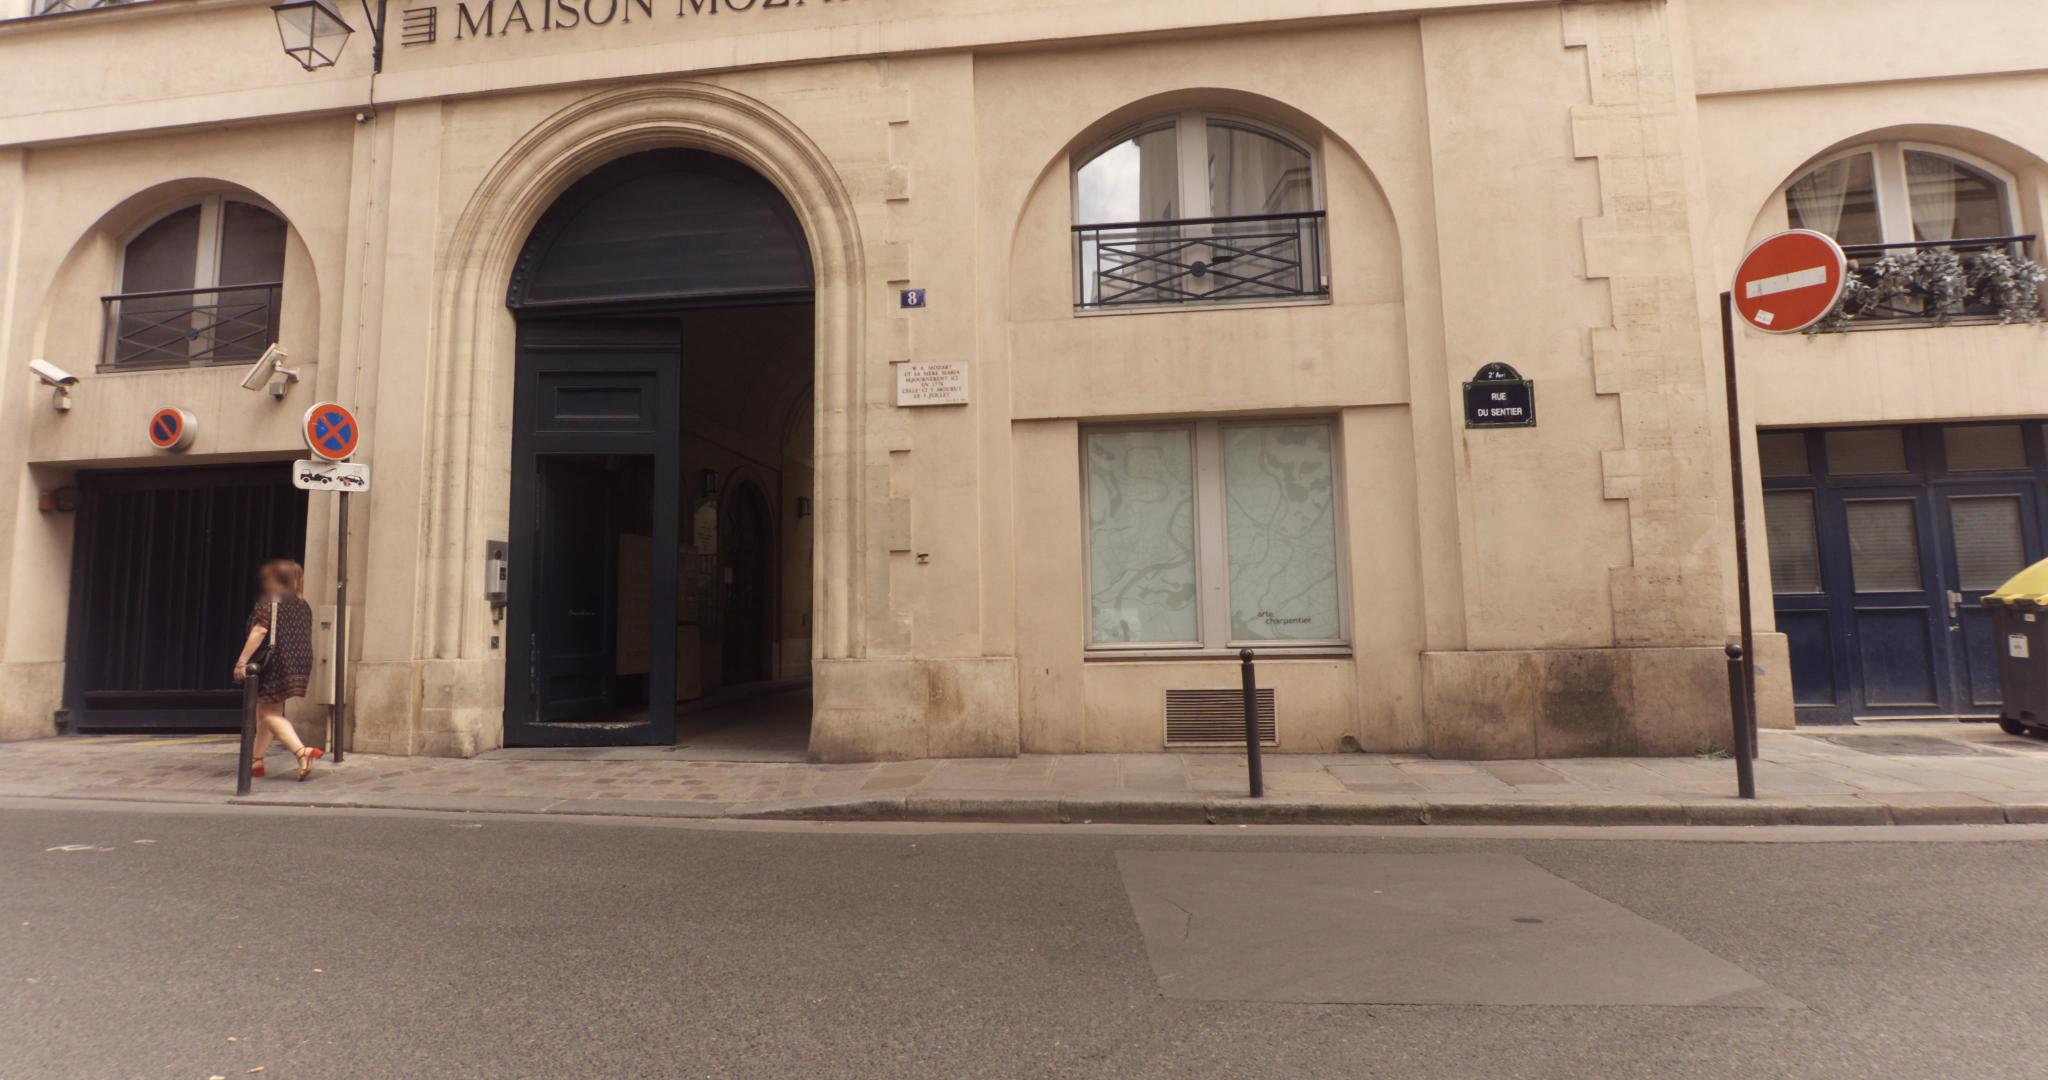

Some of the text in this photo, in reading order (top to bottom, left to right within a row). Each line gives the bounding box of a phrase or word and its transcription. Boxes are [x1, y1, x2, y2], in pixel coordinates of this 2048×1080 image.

[908, 291, 917, 305] 8
[1491, 392, 1507, 401] RUE
[1478, 407, 1523, 417] DU SENTIER
[1265, 617, 1312, 625] charpentier
